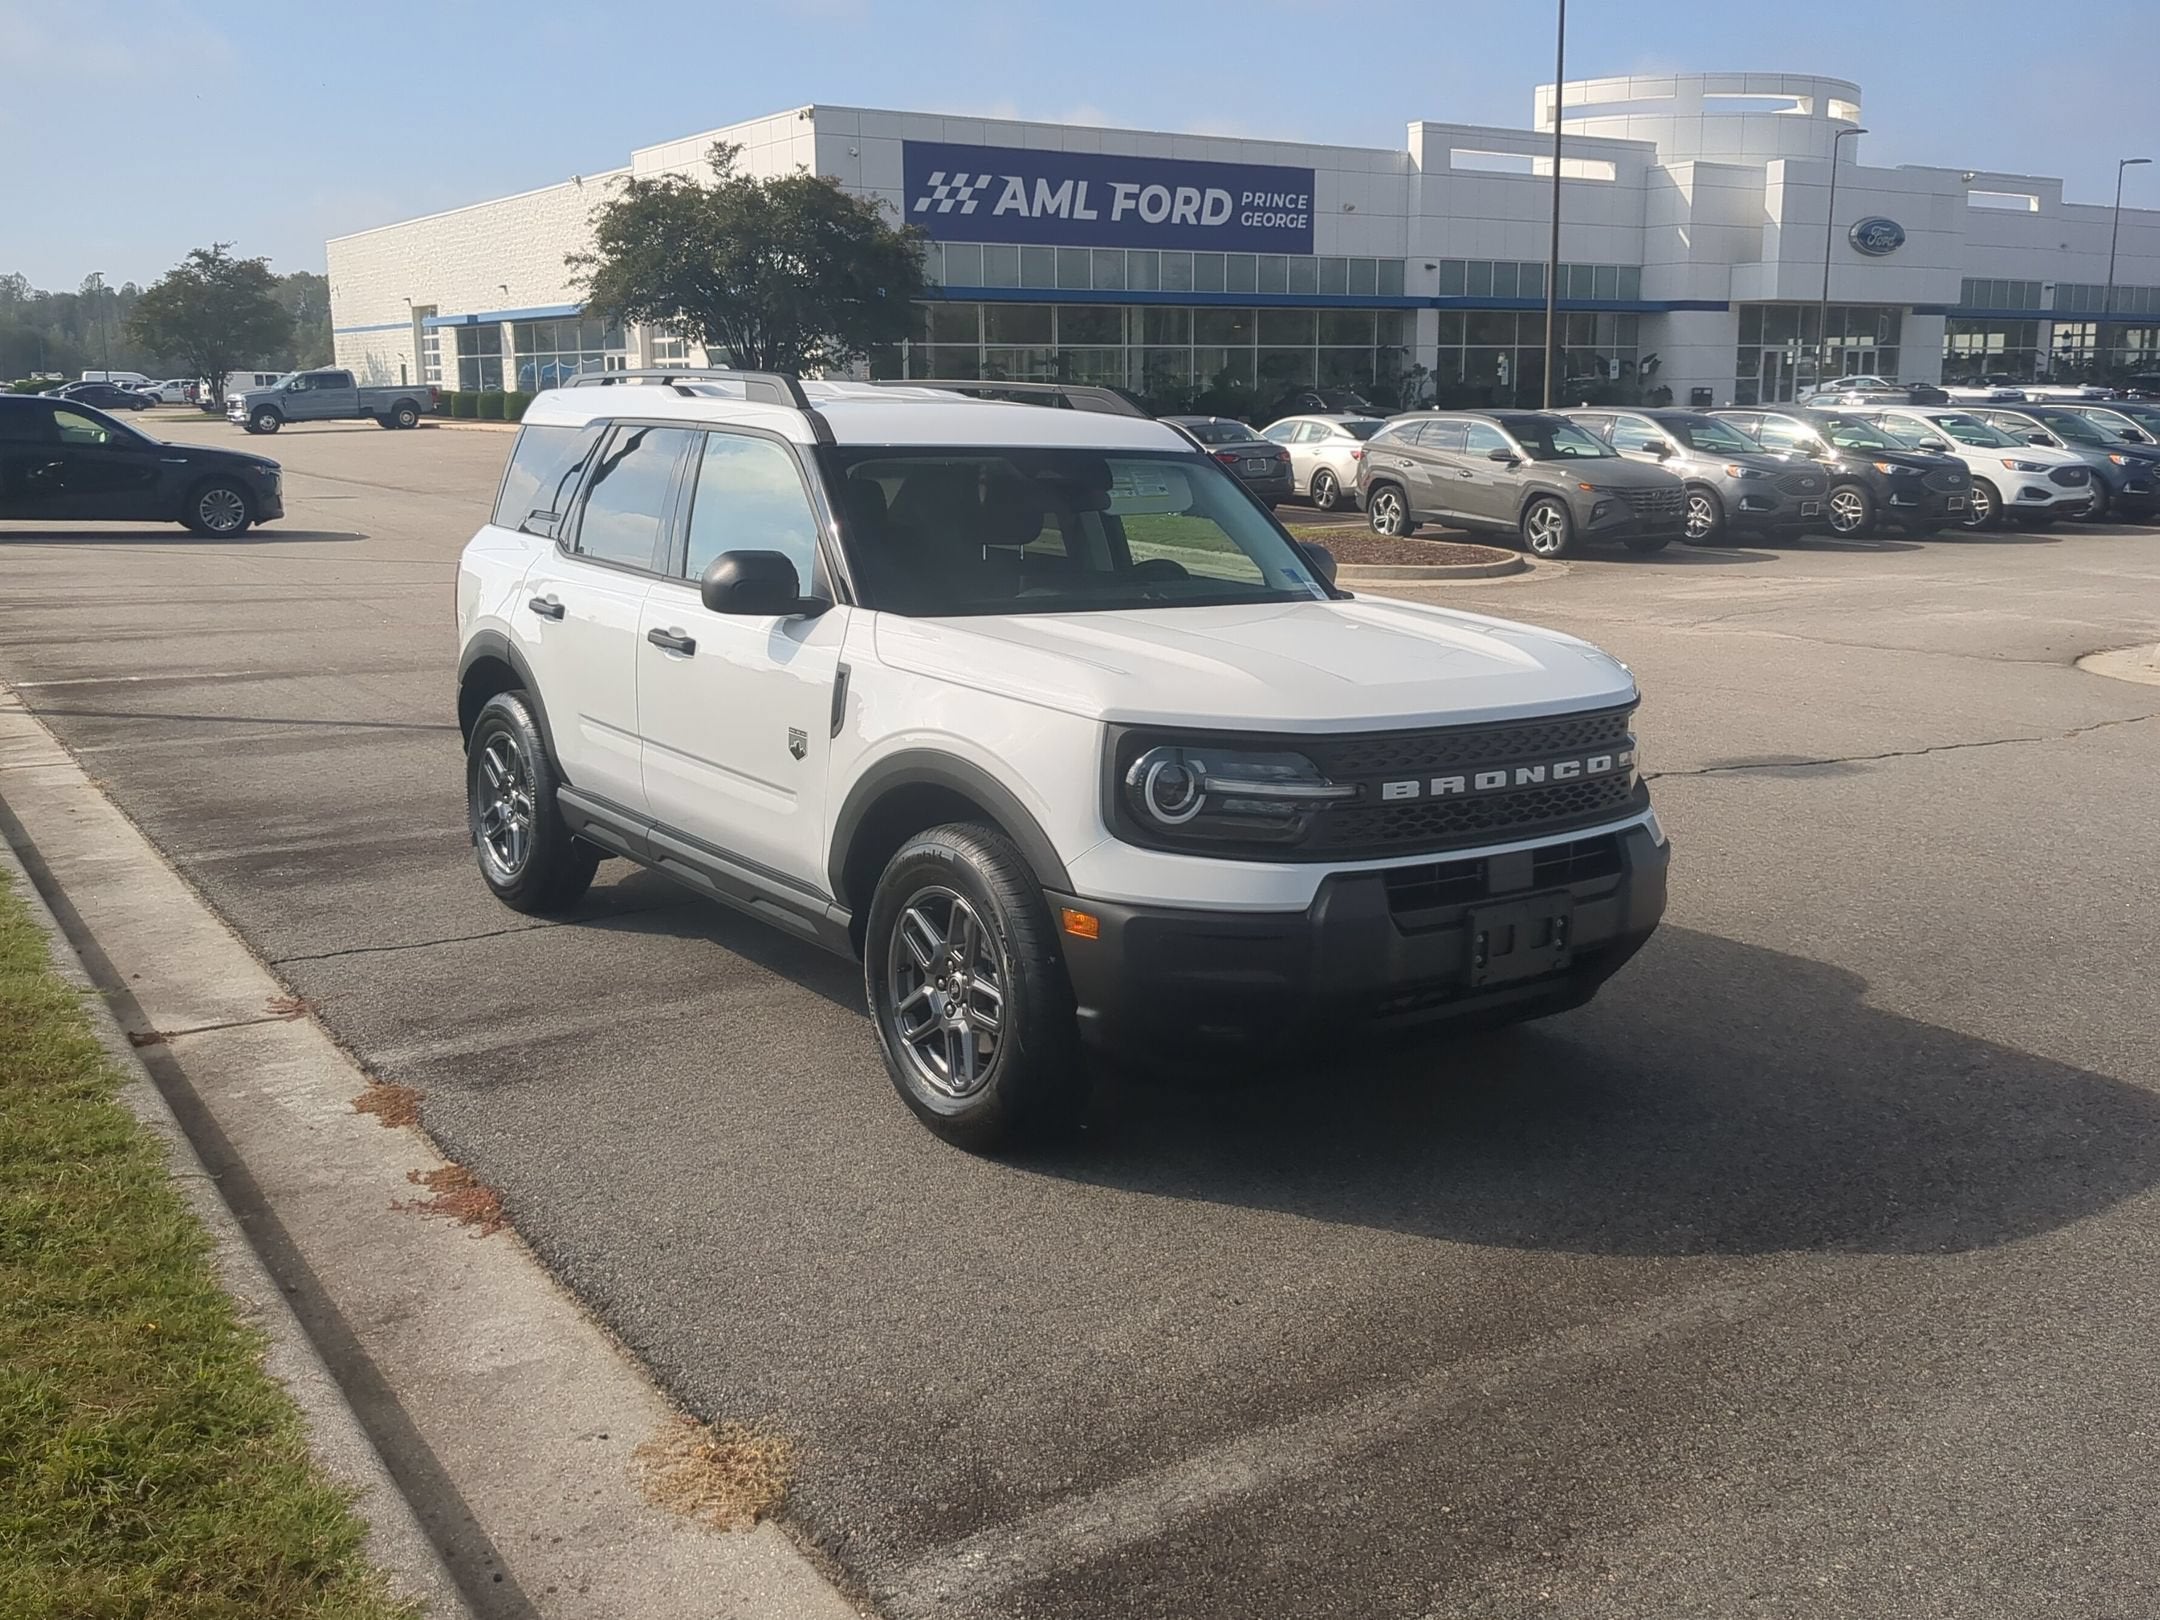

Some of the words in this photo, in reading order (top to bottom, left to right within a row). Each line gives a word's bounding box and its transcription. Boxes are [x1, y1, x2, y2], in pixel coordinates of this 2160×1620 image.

[992, 175, 1098, 220] AML
[1106, 182, 1233, 226] FORD
[1241, 191, 1308, 209] PRINCE
[1241, 211, 1308, 229] GEORGE
[1382, 755, 1612, 800] BRONCO
